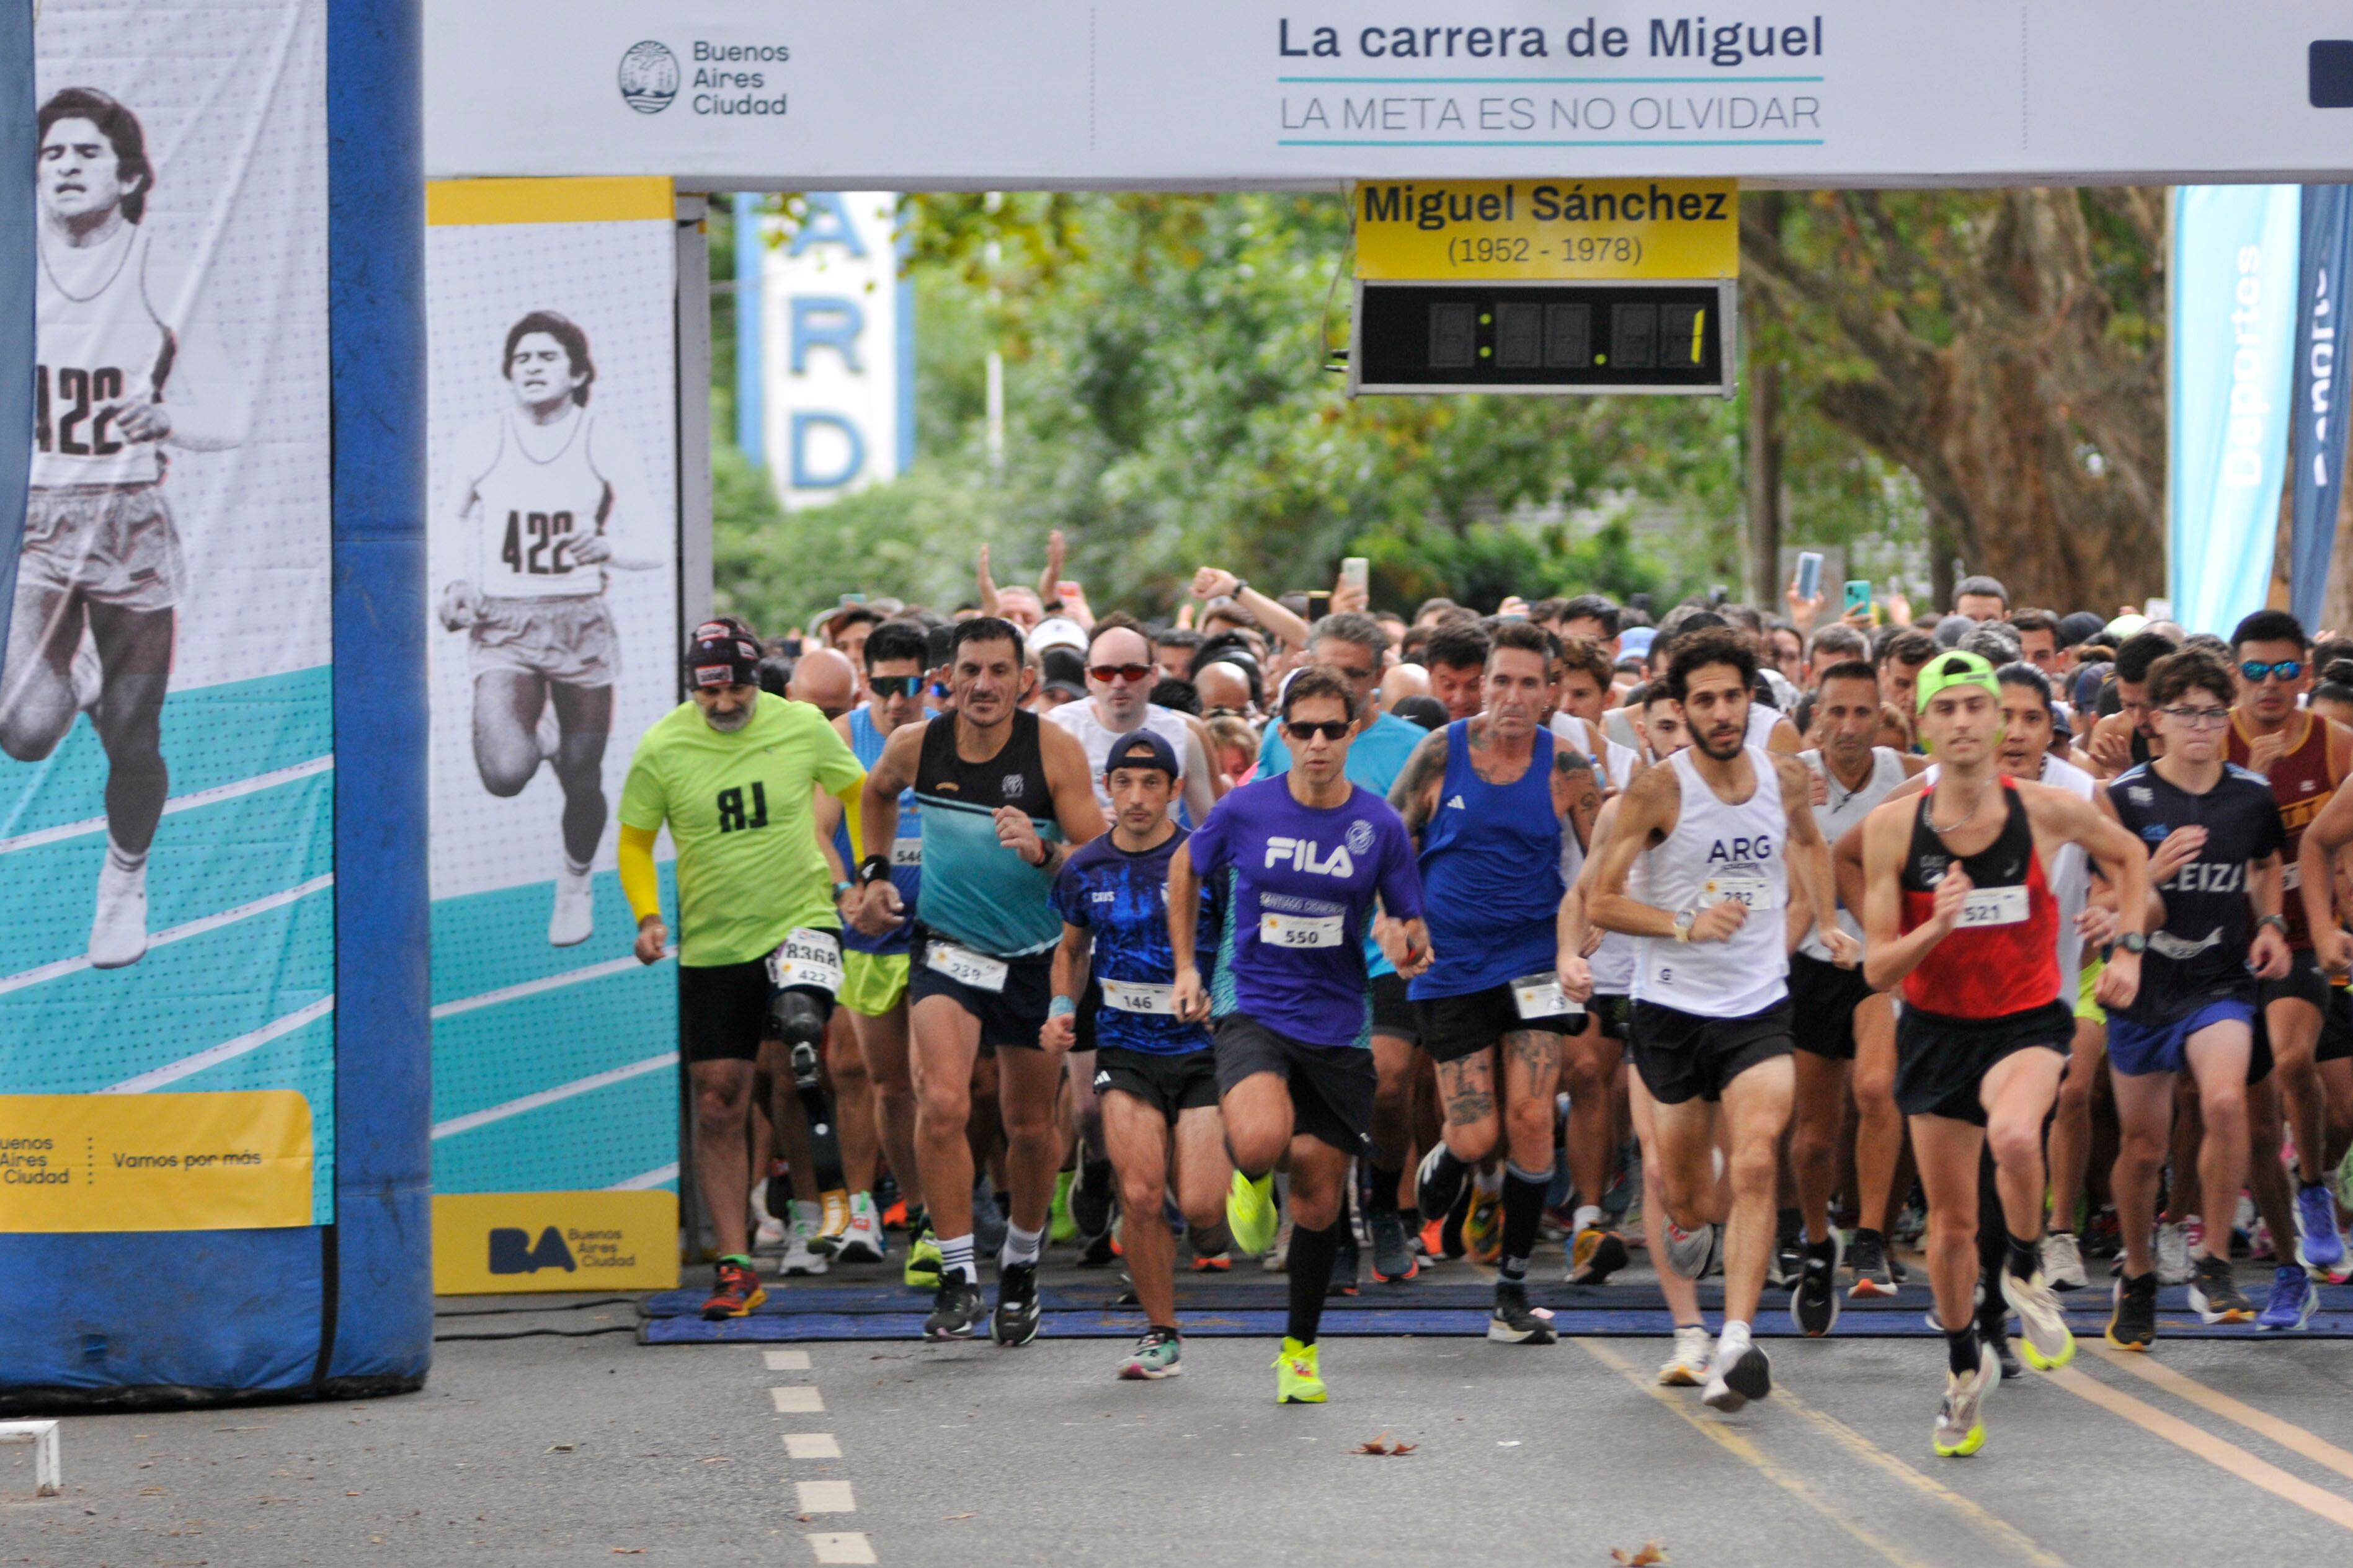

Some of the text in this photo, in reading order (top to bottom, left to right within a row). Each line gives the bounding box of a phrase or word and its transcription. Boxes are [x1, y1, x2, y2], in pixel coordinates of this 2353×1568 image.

[693, 41, 790, 62] Buenos
[1279, 16, 1821, 67] La carrera de Miguel
[693, 68, 764, 89] Aires
[693, 94, 787, 115] Ciudad
[1281, 96, 1821, 131] LA META ES NO OLVIDAR
[1365, 184, 1727, 230] Miguel Sánchez
[1448, 236, 1529, 266] (1952
[1563, 236, 1642, 266] 1978)
[502, 510, 573, 574] 422
[1264, 836, 1354, 879] FILA
[1706, 835, 1772, 863] ARG
[1965, 904, 2001, 922] 521
[1284, 931, 1319, 944] 550
[798, 970, 828, 985] 422
[1123, 995, 1153, 1009] 146
[0, 1138, 53, 1149] uenos
[0, 1152, 48, 1167] Aires
[113, 1149, 262, 1171] Vamos por más
[4, 1168, 70, 1184] Ciudad
[567, 1228, 623, 1241] Buenos
[489, 1226, 577, 1275] BA
[577, 1241, 618, 1253] Aires
[581, 1254, 636, 1267] Ciudad
